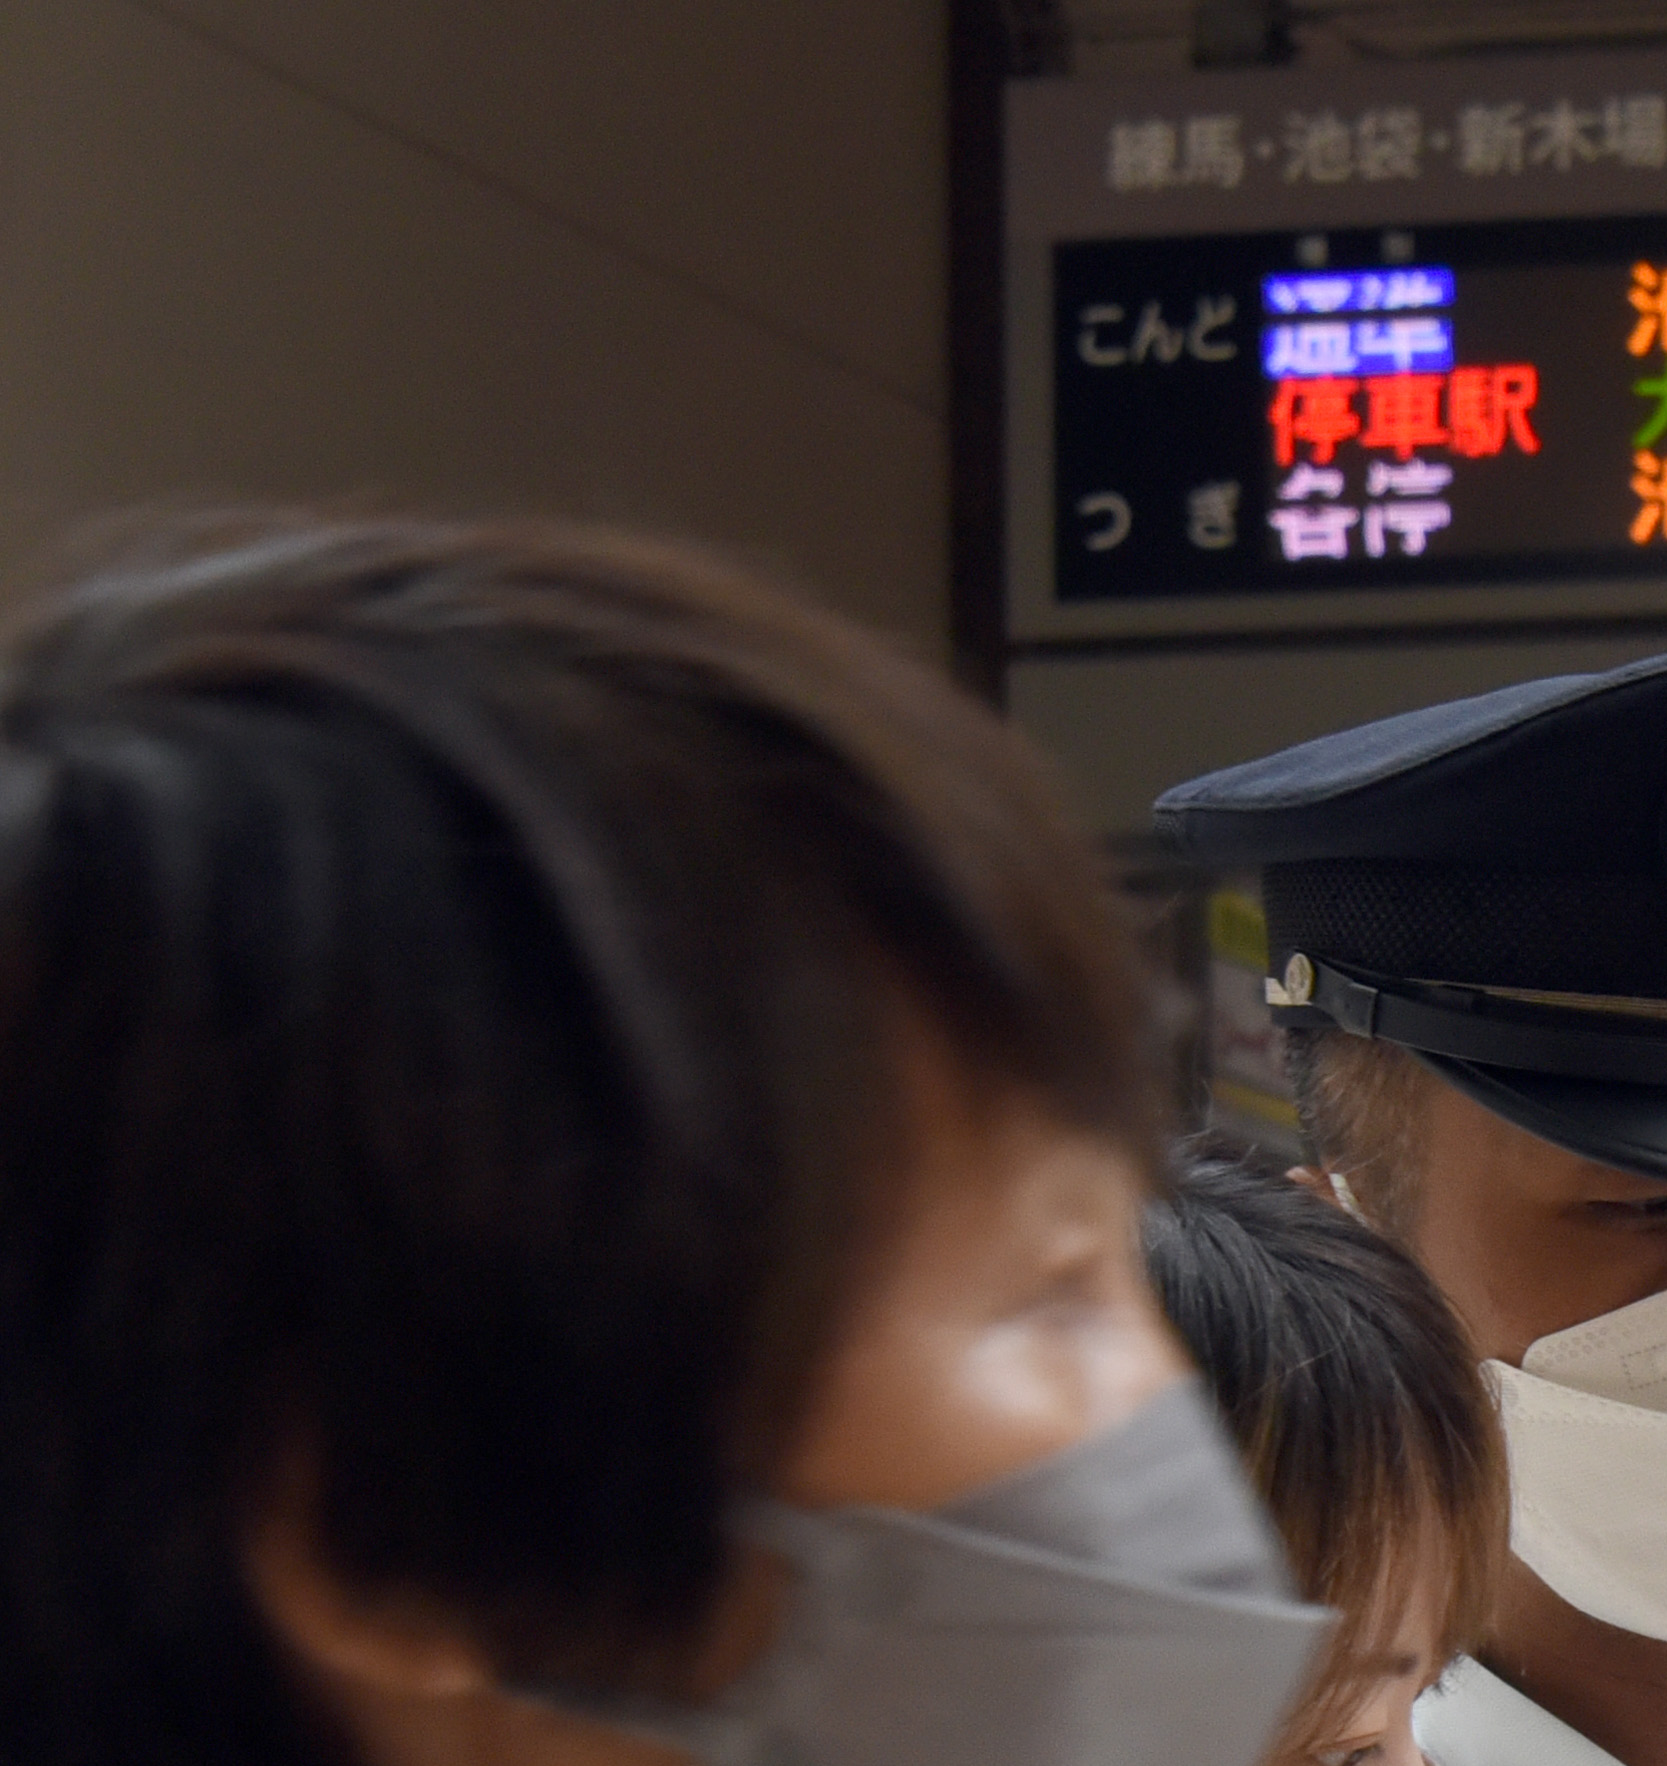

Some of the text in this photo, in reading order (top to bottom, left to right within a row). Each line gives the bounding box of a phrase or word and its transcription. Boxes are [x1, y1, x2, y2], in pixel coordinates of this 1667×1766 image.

[1078, 298, 1238, 366] こんど
[1268, 364, 1540, 467] 停車駅
[1078, 482, 1240, 550] つぎ
